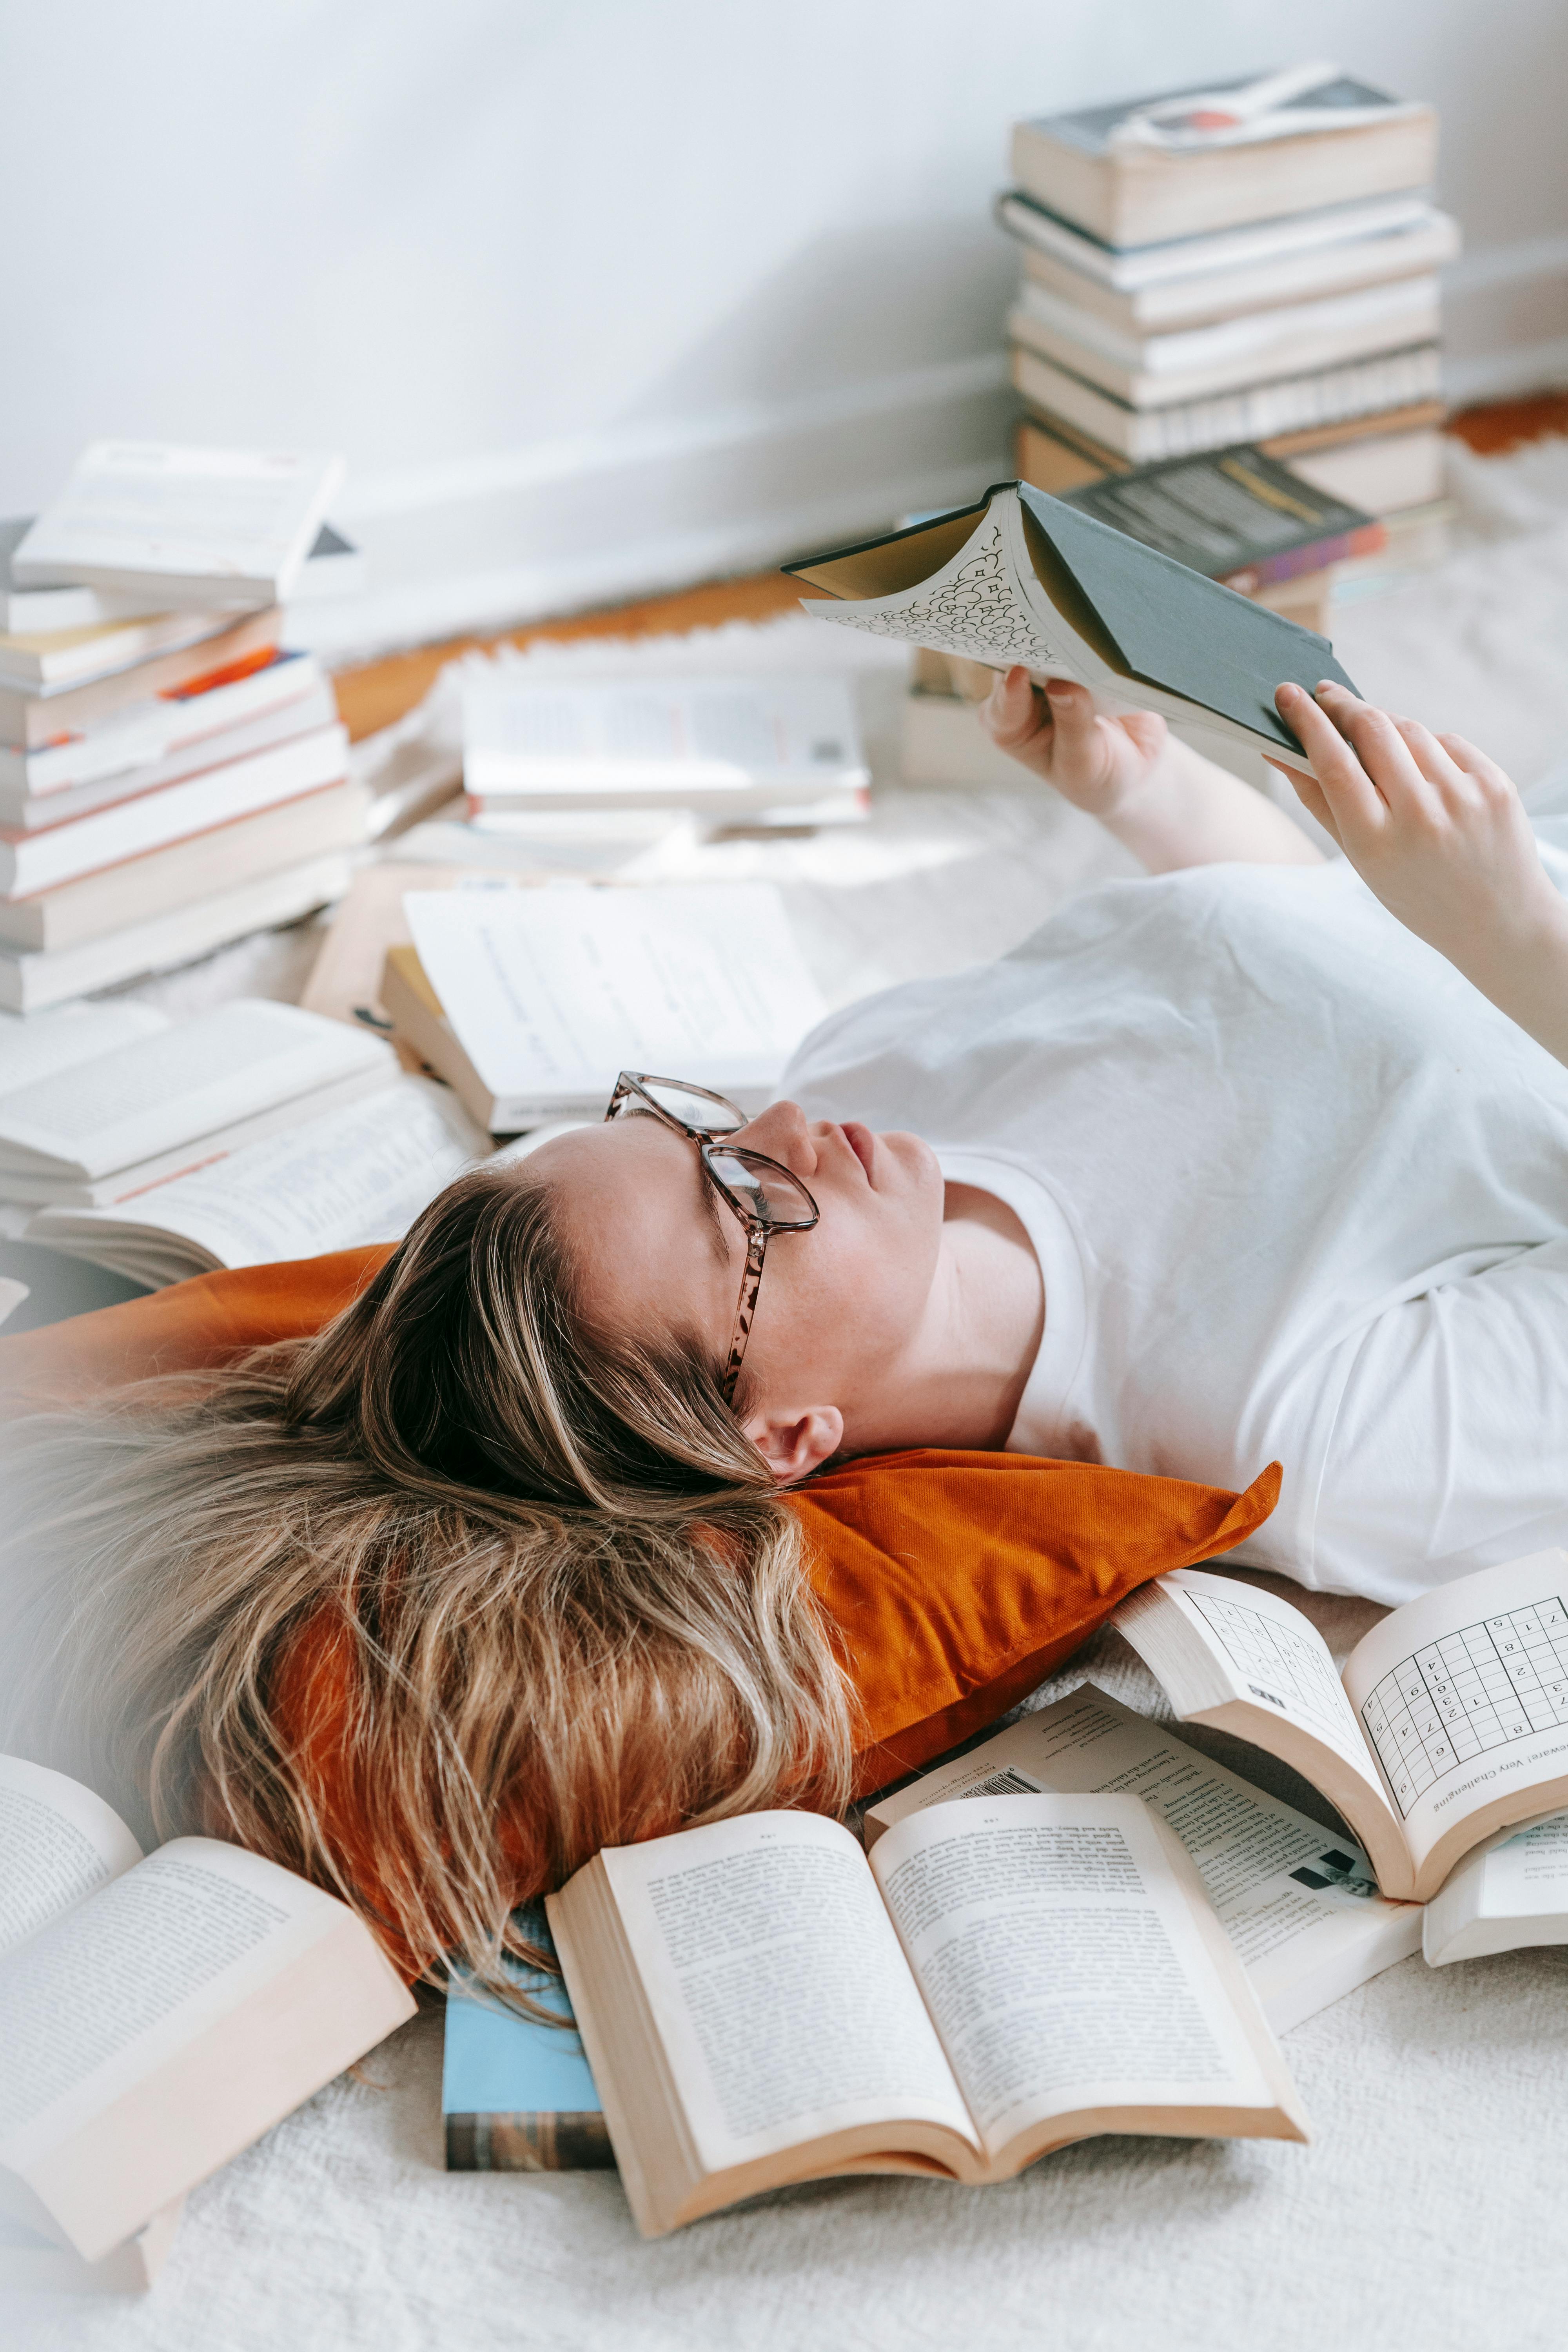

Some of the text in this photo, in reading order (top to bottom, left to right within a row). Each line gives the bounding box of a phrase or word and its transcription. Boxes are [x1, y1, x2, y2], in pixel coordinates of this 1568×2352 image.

[1427, 1662, 1436, 1670] 4
[1515, 1667, 1526, 1676] 2
[1411, 1687, 1419, 1696] 9
[1437, 1686, 1446, 1694] 6
[1367, 1700, 1372, 1710] 4
[1443, 1697, 1452, 1705] 3
[1041, 1703, 1095, 1734] Vintage International
[1447, 1708, 1457, 1718] 2
[1377, 1723, 1382, 1734] 5
[1401, 1727, 1408, 1737] 4
[1427, 1723, 1435, 1733] 7
[1152, 1749, 1169, 1759] tance
[1436, 1747, 1445, 1757] 6
[1138, 1758, 1153, 1767] with
[1499, 1760, 1524, 1772] Very
[1126, 1766, 1140, 1774] this
[1135, 1759, 1171, 1779] fascinating
[983, 1771, 1008, 1785] 781400
[1107, 1773, 1129, 1786] fabled
[1123, 1777, 1138, 1788] read
[1138, 1763, 1195, 1795] historically vibrant
[925, 1765, 996, 1806] Reading Group Guide available
[1401, 1783, 1406, 1793] 9
[1433, 1770, 1496, 1812] Challenging
[960, 1784, 986, 1799] 033881
[1163, 1778, 1218, 1808] immensely moving.
[1188, 1785, 1221, 1804] triumphant
[1207, 1795, 1223, 1804] Like
[1227, 1793, 1244, 1802] both
[1234, 1797, 1252, 1807] from
[1188, 1801, 1210, 1814] Joyce's
[1204, 1801, 1230, 1815] Turkish
[1237, 1802, 1259, 1816] parents
[1192, 1813, 1206, 1822] and
[1200, 1811, 1227, 1826] dawning
[1247, 1811, 1264, 1820] With
[1220, 1818, 1248, 1836] cinematic
[1272, 1817, 1285, 1826] that
[1231, 1825, 1254, 1838] empire.
[1240, 1828, 1267, 1844] Istanbullus
[1280, 1828, 1302, 1841] mother
[1267, 1839, 1282, 1847] first
[1278, 1837, 1305, 1852] Istanbul
[1227, 1844, 1255, 1862] refracted
[1254, 1846, 1271, 1856] held
[1267, 1849, 1279, 1859] and
[1288, 1843, 1310, 1856] world's
[1243, 1853, 1258, 1862] him
[1255, 1857, 1268, 1866] still
[1274, 1853, 1289, 1864] great
[1285, 1846, 1322, 1866] shimmering
[1242, 1863, 1258, 1873] lives
[1216, 1882, 1243, 1898] foremost
[1235, 1886, 1252, 1897] turns
[1261, 1891, 1294, 1910] aggrieving
[1290, 1896, 1303, 1904] way
